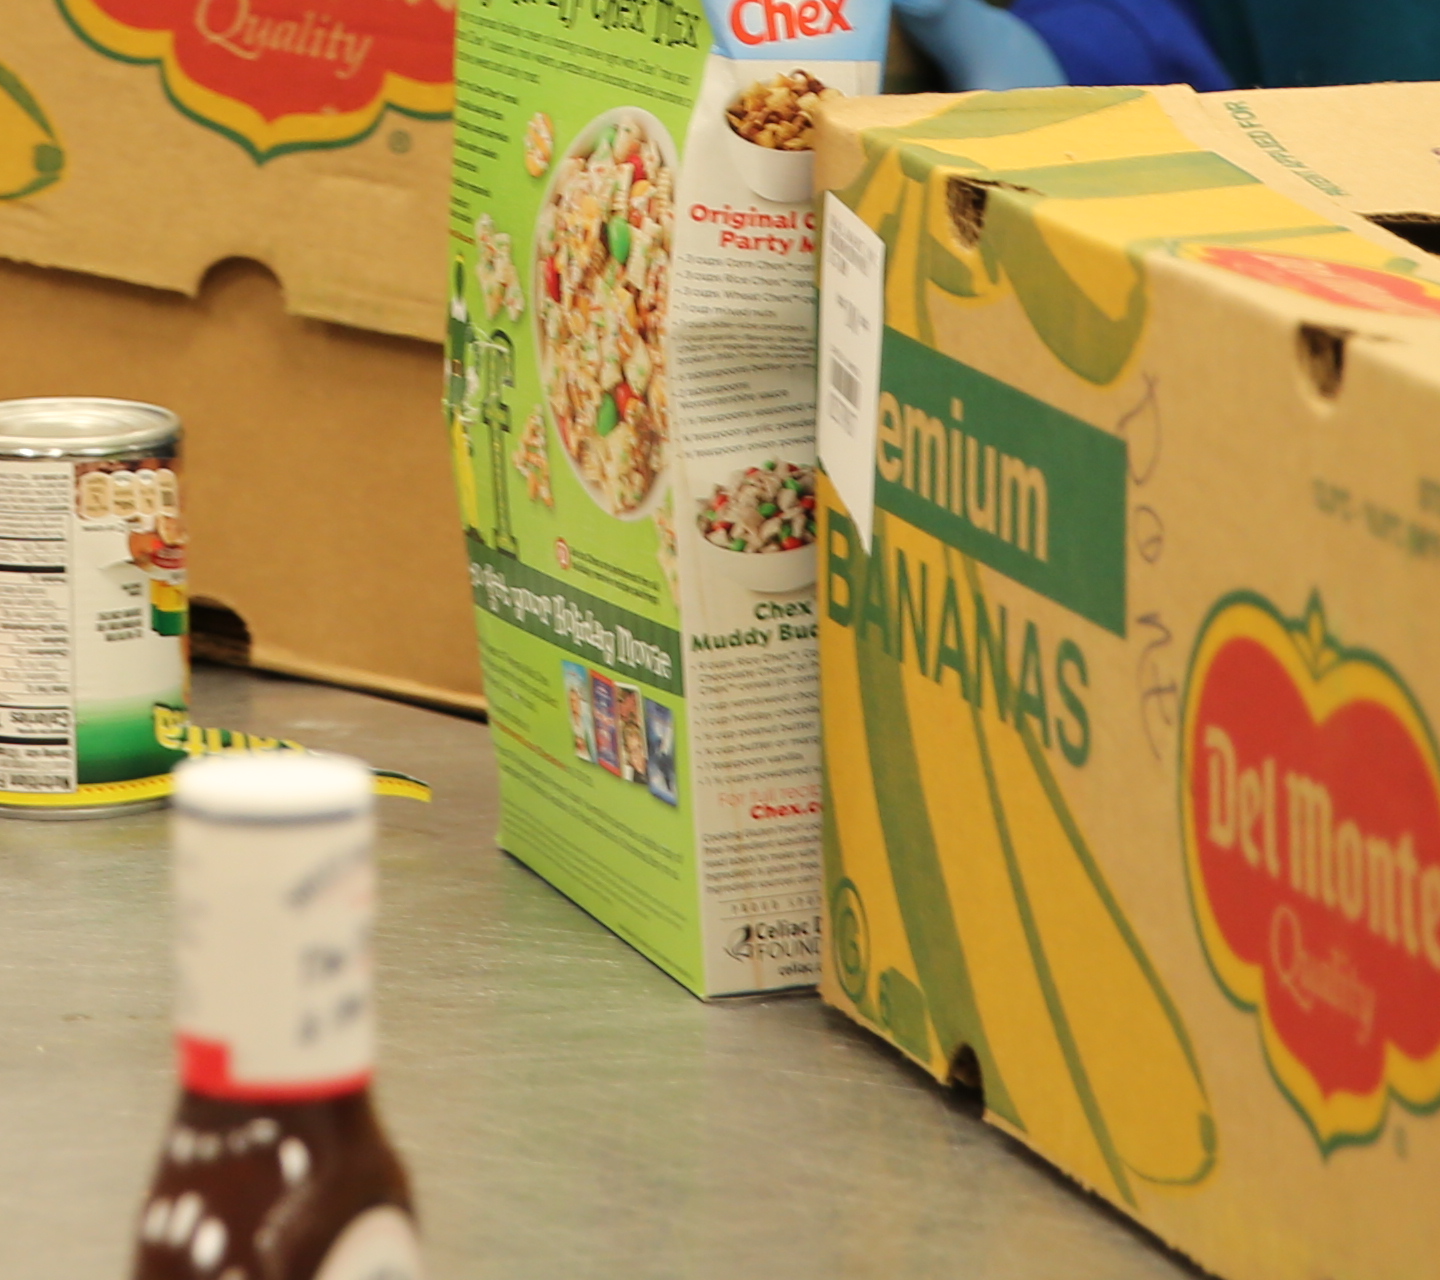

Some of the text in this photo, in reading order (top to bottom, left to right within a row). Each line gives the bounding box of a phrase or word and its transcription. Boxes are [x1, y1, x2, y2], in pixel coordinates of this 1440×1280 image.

[1224, 100, 1258, 126] FOR
[690, 204, 798, 229] Original
[719, 231, 792, 255] Party
[877, 387, 1051, 563] emium
[755, 601, 812, 620] Chex
[692, 627, 770, 652] Muddy
[825, 508, 1094, 769] BANANAS
[1206, 727, 1279, 875] Del
[756, 921, 809, 940] Celiac
[1269, 906, 1378, 1047] Quality
